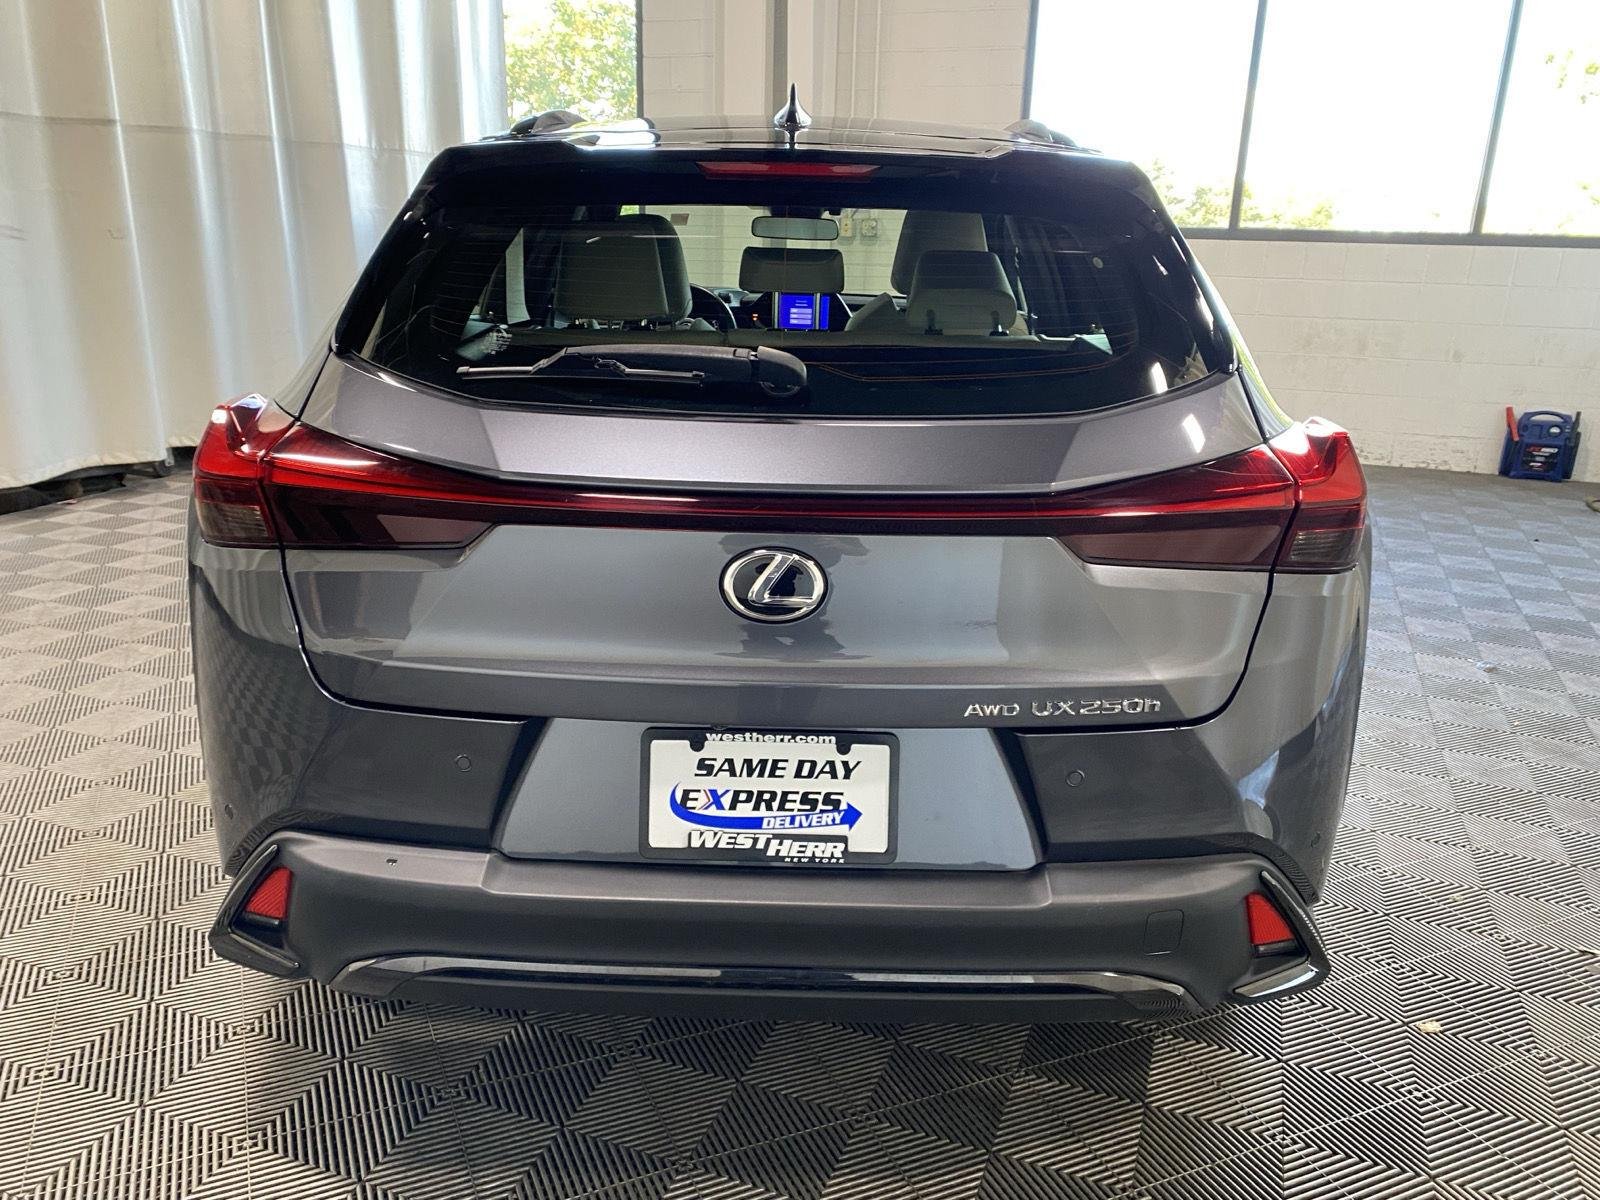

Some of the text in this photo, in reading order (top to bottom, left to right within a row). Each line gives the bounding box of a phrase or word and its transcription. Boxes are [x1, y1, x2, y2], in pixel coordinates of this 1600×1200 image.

[963, 703, 1020, 718] AWD
[705, 731, 837, 745] westherr.com
[694, 757, 862, 780] SAME DAY
[680, 788, 844, 814] EXPRESS
[761, 811, 845, 830] DELIVERY
